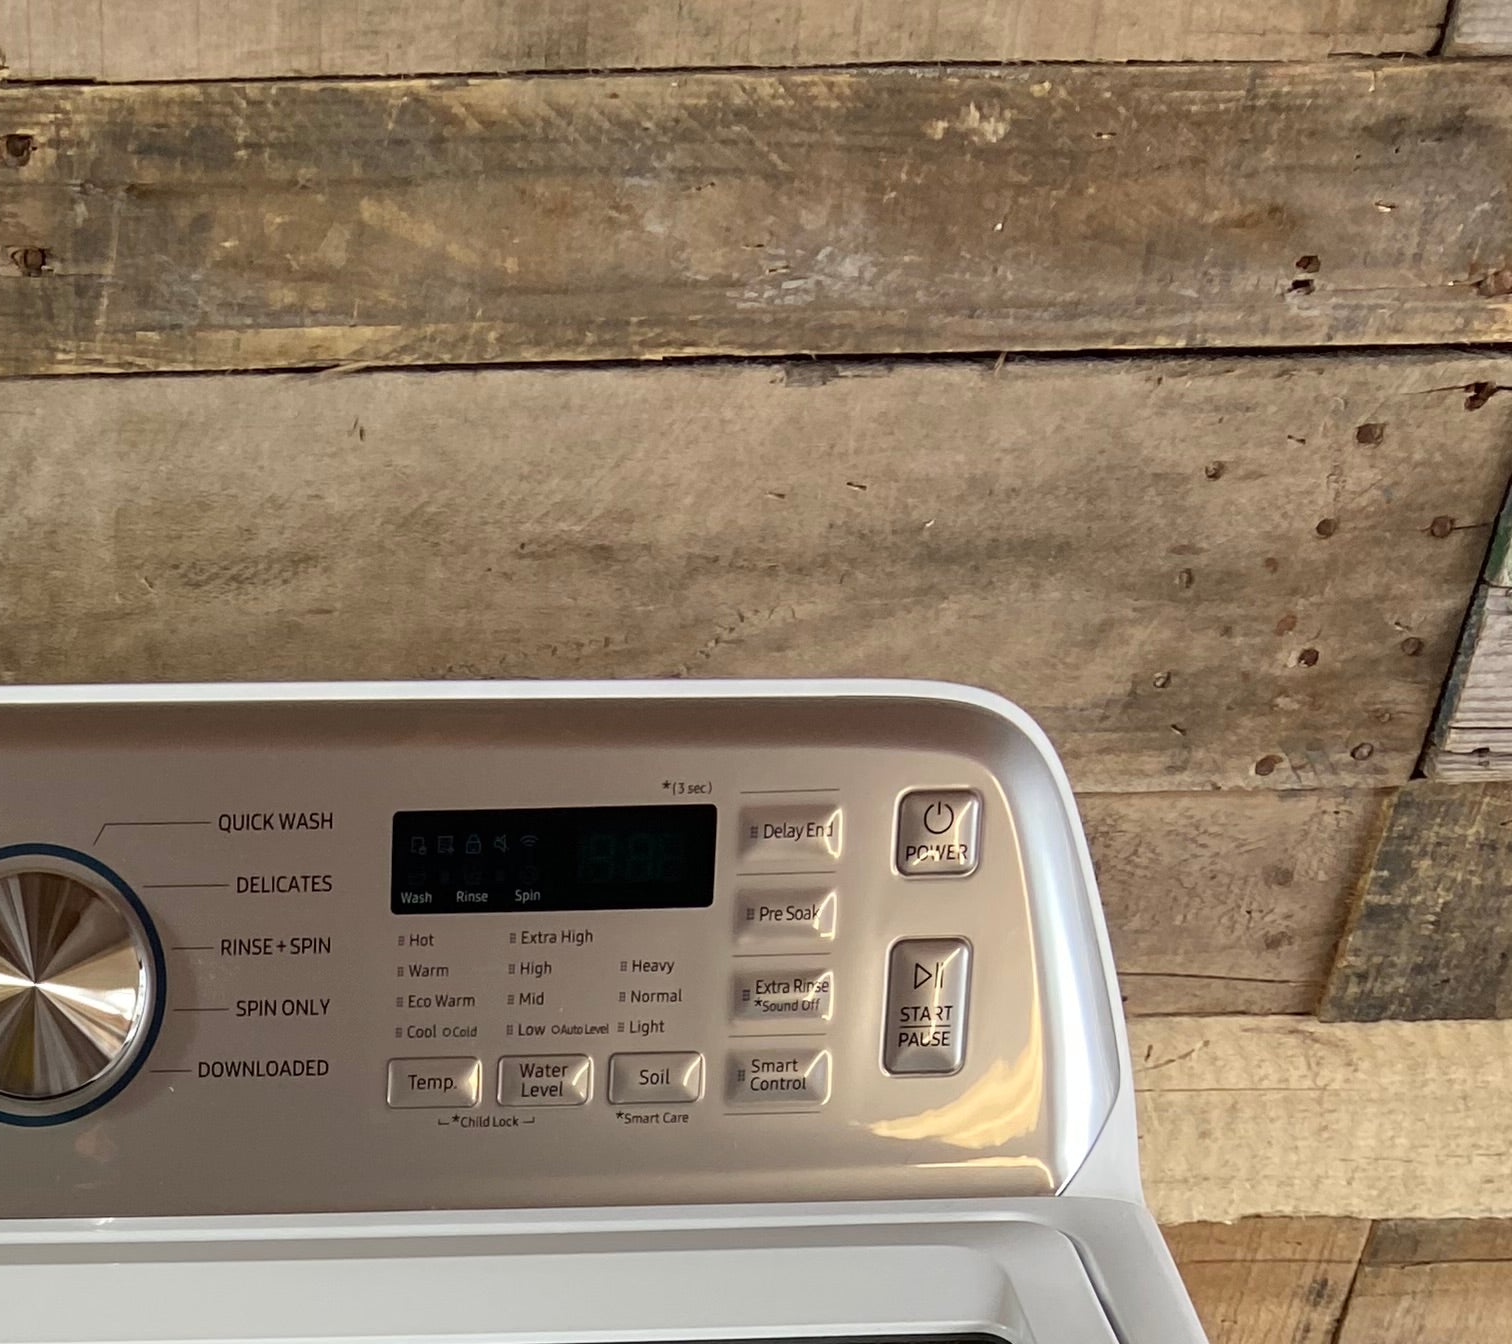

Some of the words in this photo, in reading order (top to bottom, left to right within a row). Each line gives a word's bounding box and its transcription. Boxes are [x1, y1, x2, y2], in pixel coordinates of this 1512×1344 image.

[218, 814, 272, 834] QUICK
[277, 813, 333, 831] WASH
[763, 824, 804, 840] Delay
[807, 822, 833, 837] End
[906, 845, 967, 861] POWER
[237, 876, 332, 894] DELICATES
[401, 891, 432, 904] Wash
[457, 890, 488, 902] Rinse
[515, 889, 540, 903] Spin
[760, 907, 783, 921] Pre
[786, 904, 820, 921] Soak
[410, 934, 434, 947] Hot
[521, 930, 557, 944] Extra
[561, 930, 593, 946] High
[221, 939, 273, 956] RINSE
[290, 937, 331, 954] SPIN
[409, 964, 449, 977] Warm
[520, 961, 552, 978] High
[632, 959, 674, 975] Heavy
[756, 980, 790, 994] Extra
[793, 979, 829, 993] Rinse
[408, 995, 432, 1008] Eco
[435, 994, 475, 1007] Warm
[520, 992, 544, 1006] Mid
[631, 989, 682, 1003] Normal
[237, 1000, 278, 1017] SPIN
[282, 999, 330, 1016] ONLY
[900, 1006, 952, 1022] START
[407, 1025, 437, 1039] Cool
[518, 1023, 545, 1037] Low
[629, 1021, 665, 1035] Light
[899, 1032, 950, 1047] PAUSE
[198, 1060, 329, 1077] DOWNLOADED
[520, 1063, 568, 1078] Water
[751, 1059, 798, 1073] Smart
[408, 1074, 457, 1092] Temp.
[639, 1069, 670, 1085] Soil
[750, 1077, 806, 1091] Control
[521, 1082, 563, 1097] Level
[492, 1116, 519, 1127] Lock
[663, 1112, 689, 1123] Care
